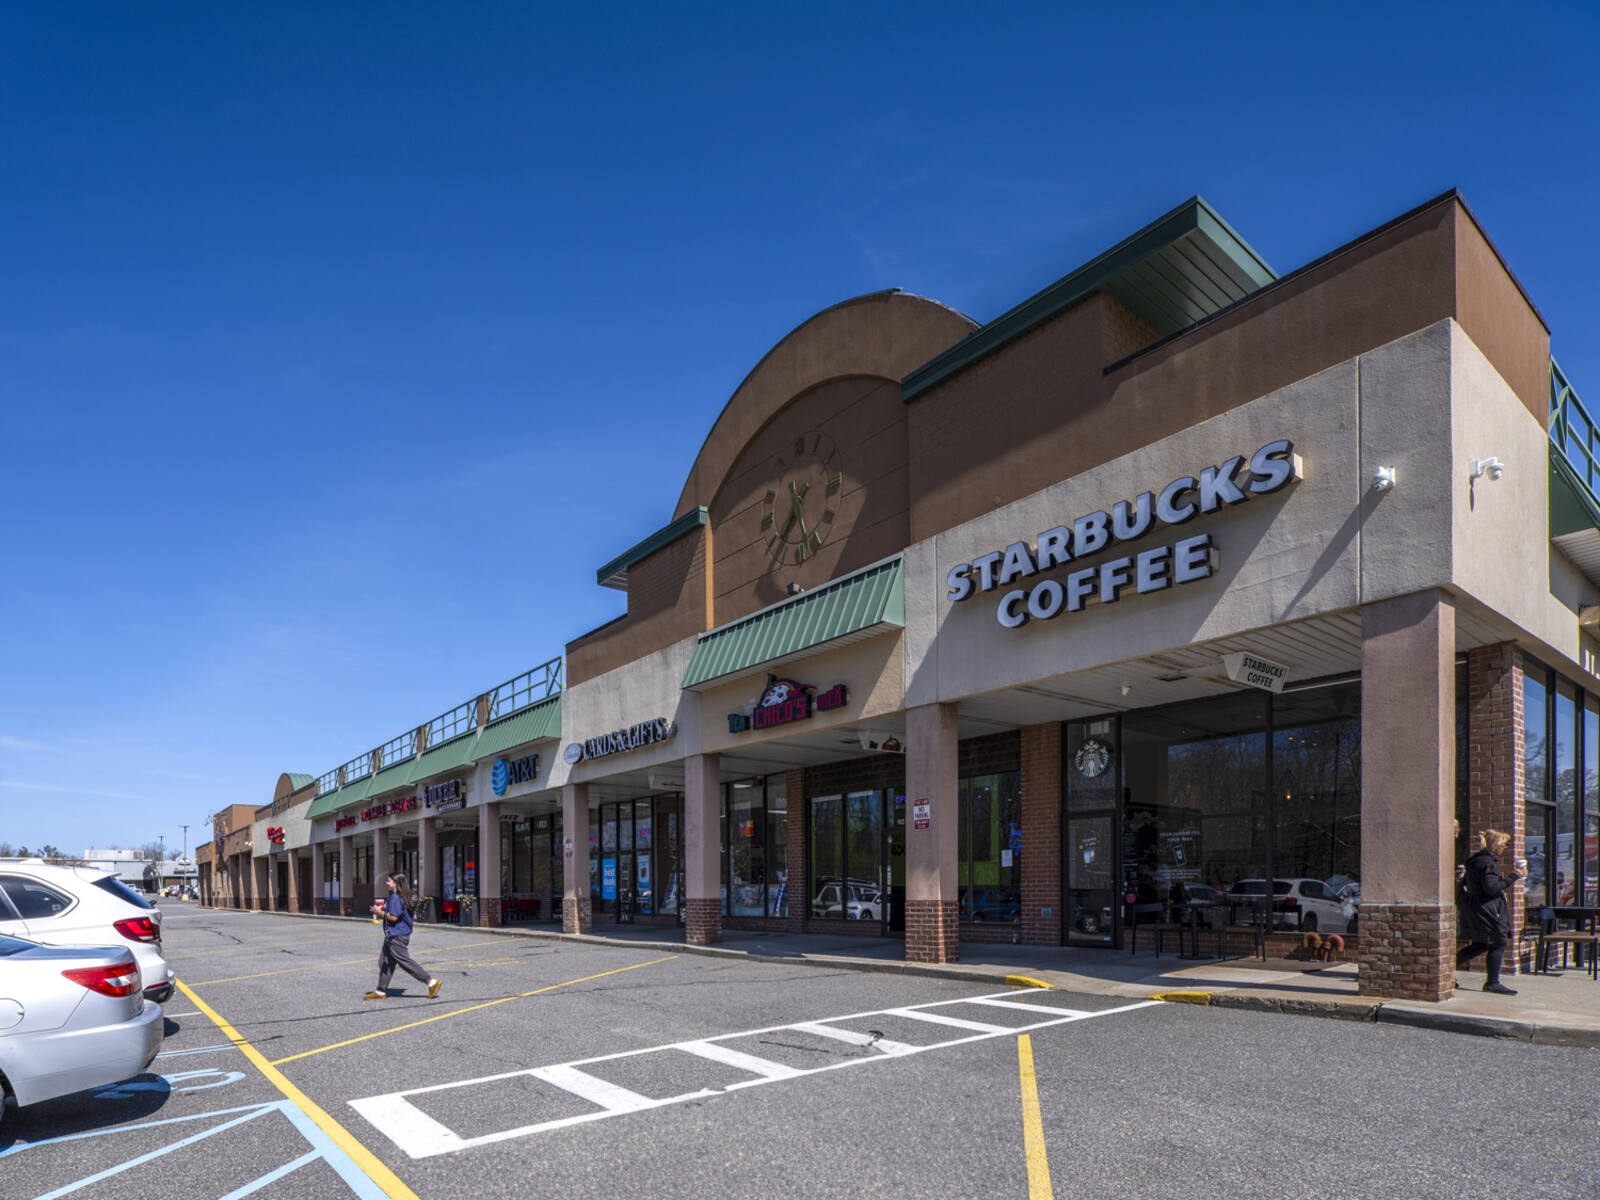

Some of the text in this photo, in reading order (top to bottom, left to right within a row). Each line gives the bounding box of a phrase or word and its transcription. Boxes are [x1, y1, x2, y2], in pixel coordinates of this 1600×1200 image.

[946, 439, 1295, 602] STARBUCKS
[997, 533, 1214, 629] COFFEE
[1242, 657, 1284, 678] STARBUCKS
[1247, 672, 1274, 688] COFFEE
[754, 696, 806, 730] CHICO'S
[584, 731, 618, 761] CARDS
[618, 729, 628, 752] &
[628, 716, 667, 748] GIFTS
[508, 754, 538, 785] AT&T
